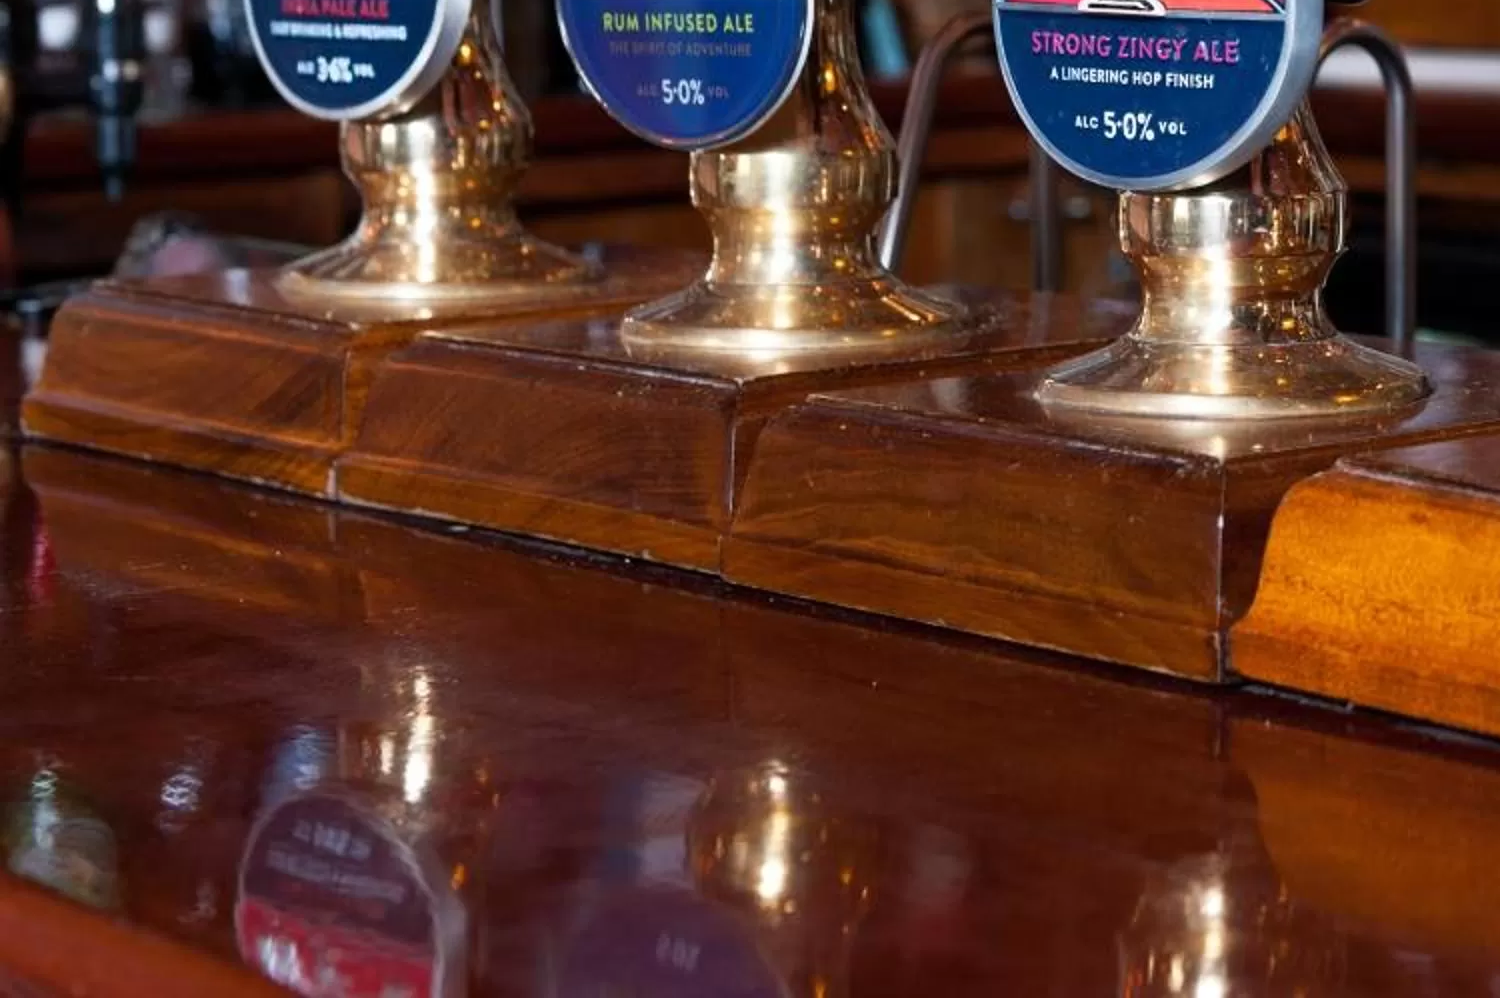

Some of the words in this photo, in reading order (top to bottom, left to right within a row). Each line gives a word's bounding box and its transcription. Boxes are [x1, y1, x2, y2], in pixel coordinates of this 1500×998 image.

[602, 12, 640, 33] RUM
[644, 12, 718, 33] INFUSED
[723, 13, 755, 33] ALE
[1031, 30, 1111, 58] STRONG
[1117, 36, 1188, 62] ZINGY
[1193, 38, 1241, 64] ALE
[1050, 66, 1059, 81] A
[1061, 66, 1129, 85] LINGERING
[1132, 71, 1162, 87] HOP
[1165, 73, 1215, 89] FINISH
[1075, 115, 1099, 129] ALC
[1158, 121, 1187, 135] VOL
